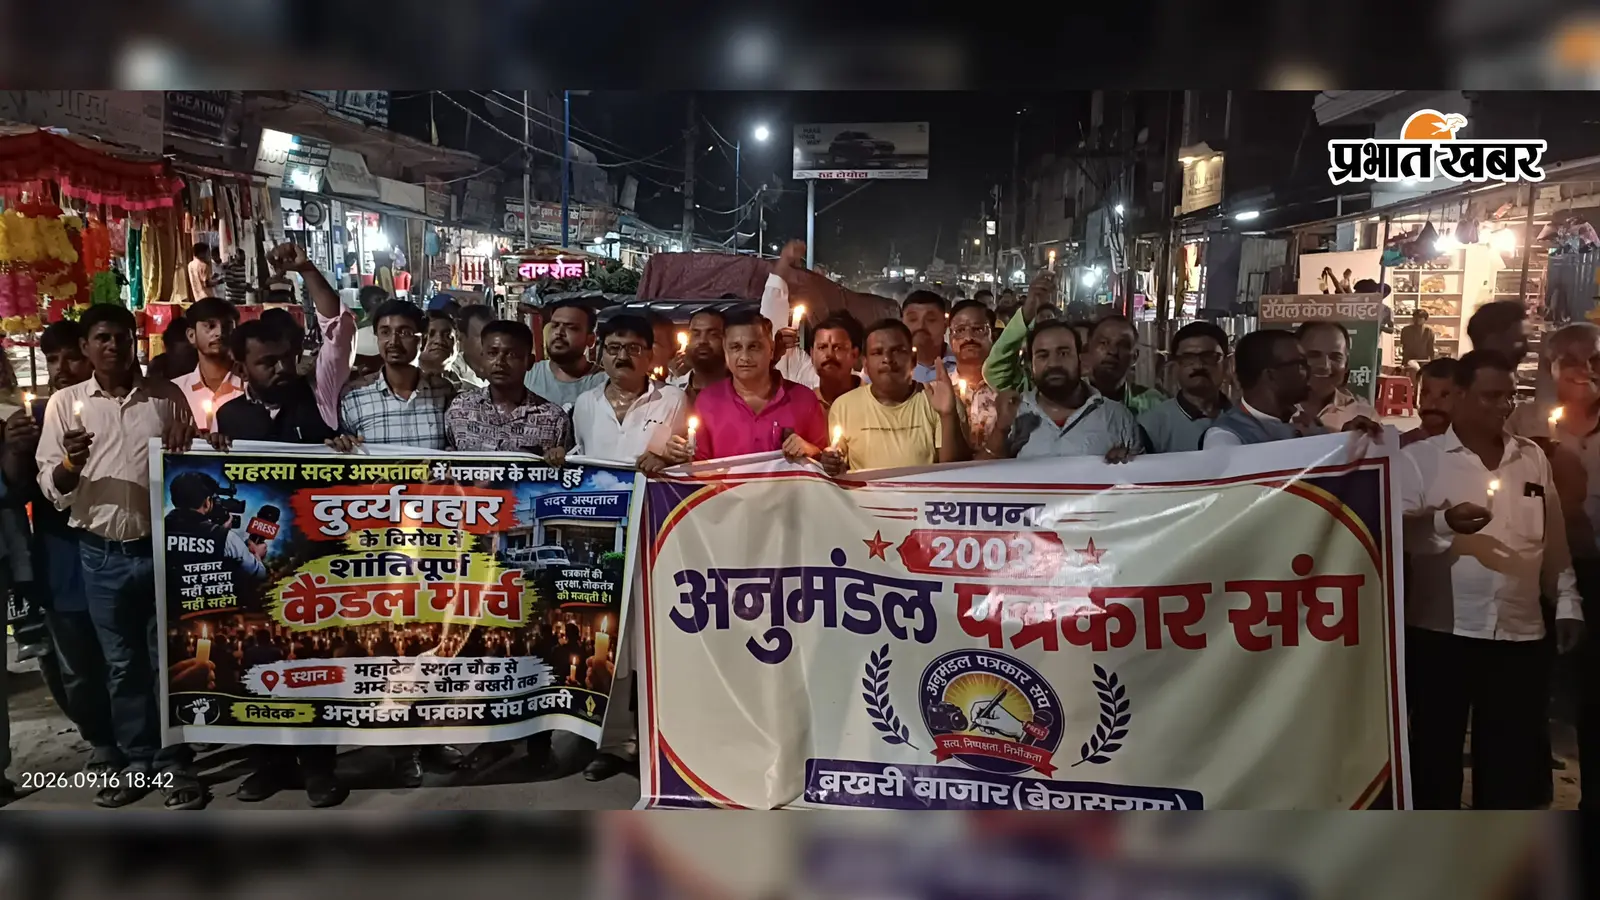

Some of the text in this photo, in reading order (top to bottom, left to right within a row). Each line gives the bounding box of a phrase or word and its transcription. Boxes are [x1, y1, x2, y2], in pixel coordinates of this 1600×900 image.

[166, 91, 225, 118] CREATION
[1262, 296, 1379, 320] रॉयल केक प्वाइंट
[225, 462, 584, 488] सहरसा सदर अस्पताल में पत्रकार के साथ हुई
[310, 484, 503, 536] दुर्व्यवहार
[544, 495, 619, 506] सदर अस्पताल
[562, 506, 596, 515] सहरसा
[925, 501, 1046, 527] स्थापना
[251, 519, 277, 535] PRESS
[167, 535, 215, 554] PRESS
[359, 528, 464, 547] के विरोध में
[184, 561, 223, 573] पत्रकार
[330, 552, 471, 581] शांतिपूर्ण
[562, 567, 603, 579] पत्रकारों की
[182, 571, 232, 585] पर हमला
[555, 579, 614, 590] सुरक्षा, लोकतंत्र
[181, 581, 234, 598] नहीं सहेंगे
[282, 570, 524, 624] कैंडल मार्च
[557, 590, 569, 600] की
[182, 593, 237, 611] नहीं सहेंगे
[669, 547, 1366, 665] अनुमंडल पत्रकार संघ
[421, 662, 462, 677] स्थान
[467, 658, 501, 675] चौक
[505, 658, 519, 674] से
[926, 655, 972, 696] अनुमंडल
[976, 655, 1032, 685] पत्रकार
[434, 676, 470, 693] चौक
[474, 675, 514, 692] बखरी
[517, 673, 539, 689] तक
[245, 704, 296, 719] निवेदक
[322, 688, 574, 726] अनुमंडल पत्रकार संघ बखरी
[1025, 723, 1046, 737] PRESS
[819, 767, 906, 797] बखरी
